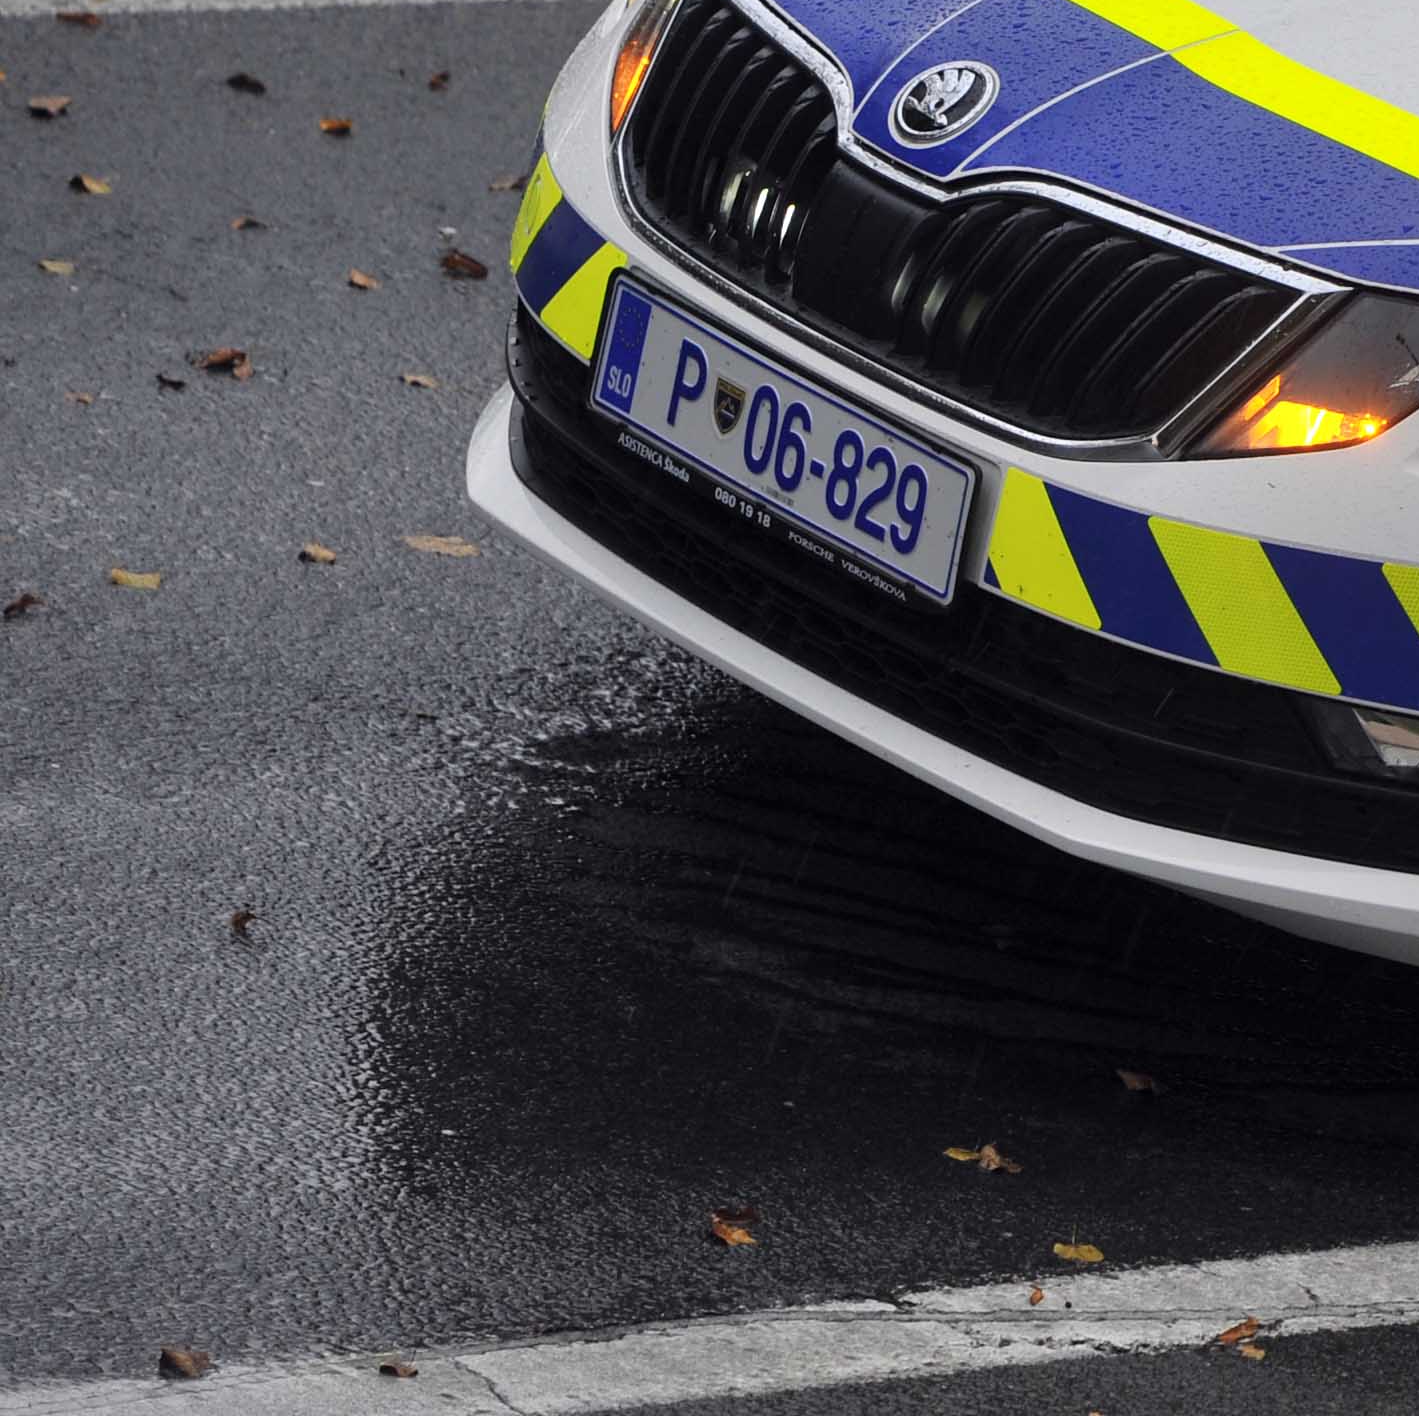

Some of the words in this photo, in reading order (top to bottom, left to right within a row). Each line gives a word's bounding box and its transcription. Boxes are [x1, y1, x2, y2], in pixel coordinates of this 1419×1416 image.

[607, 366, 632, 398] SLO
[617, 432, 663, 468] ASISTENCA
[663, 455, 690, 483] Škoda
[667, 338, 708, 427] P
[744, 384, 928, 555] 06-829
[714, 487, 737, 509] 080
[739, 501, 753, 518] 19
[757, 511, 771, 528] 18
[788, 531, 835, 563] PORSCHE
